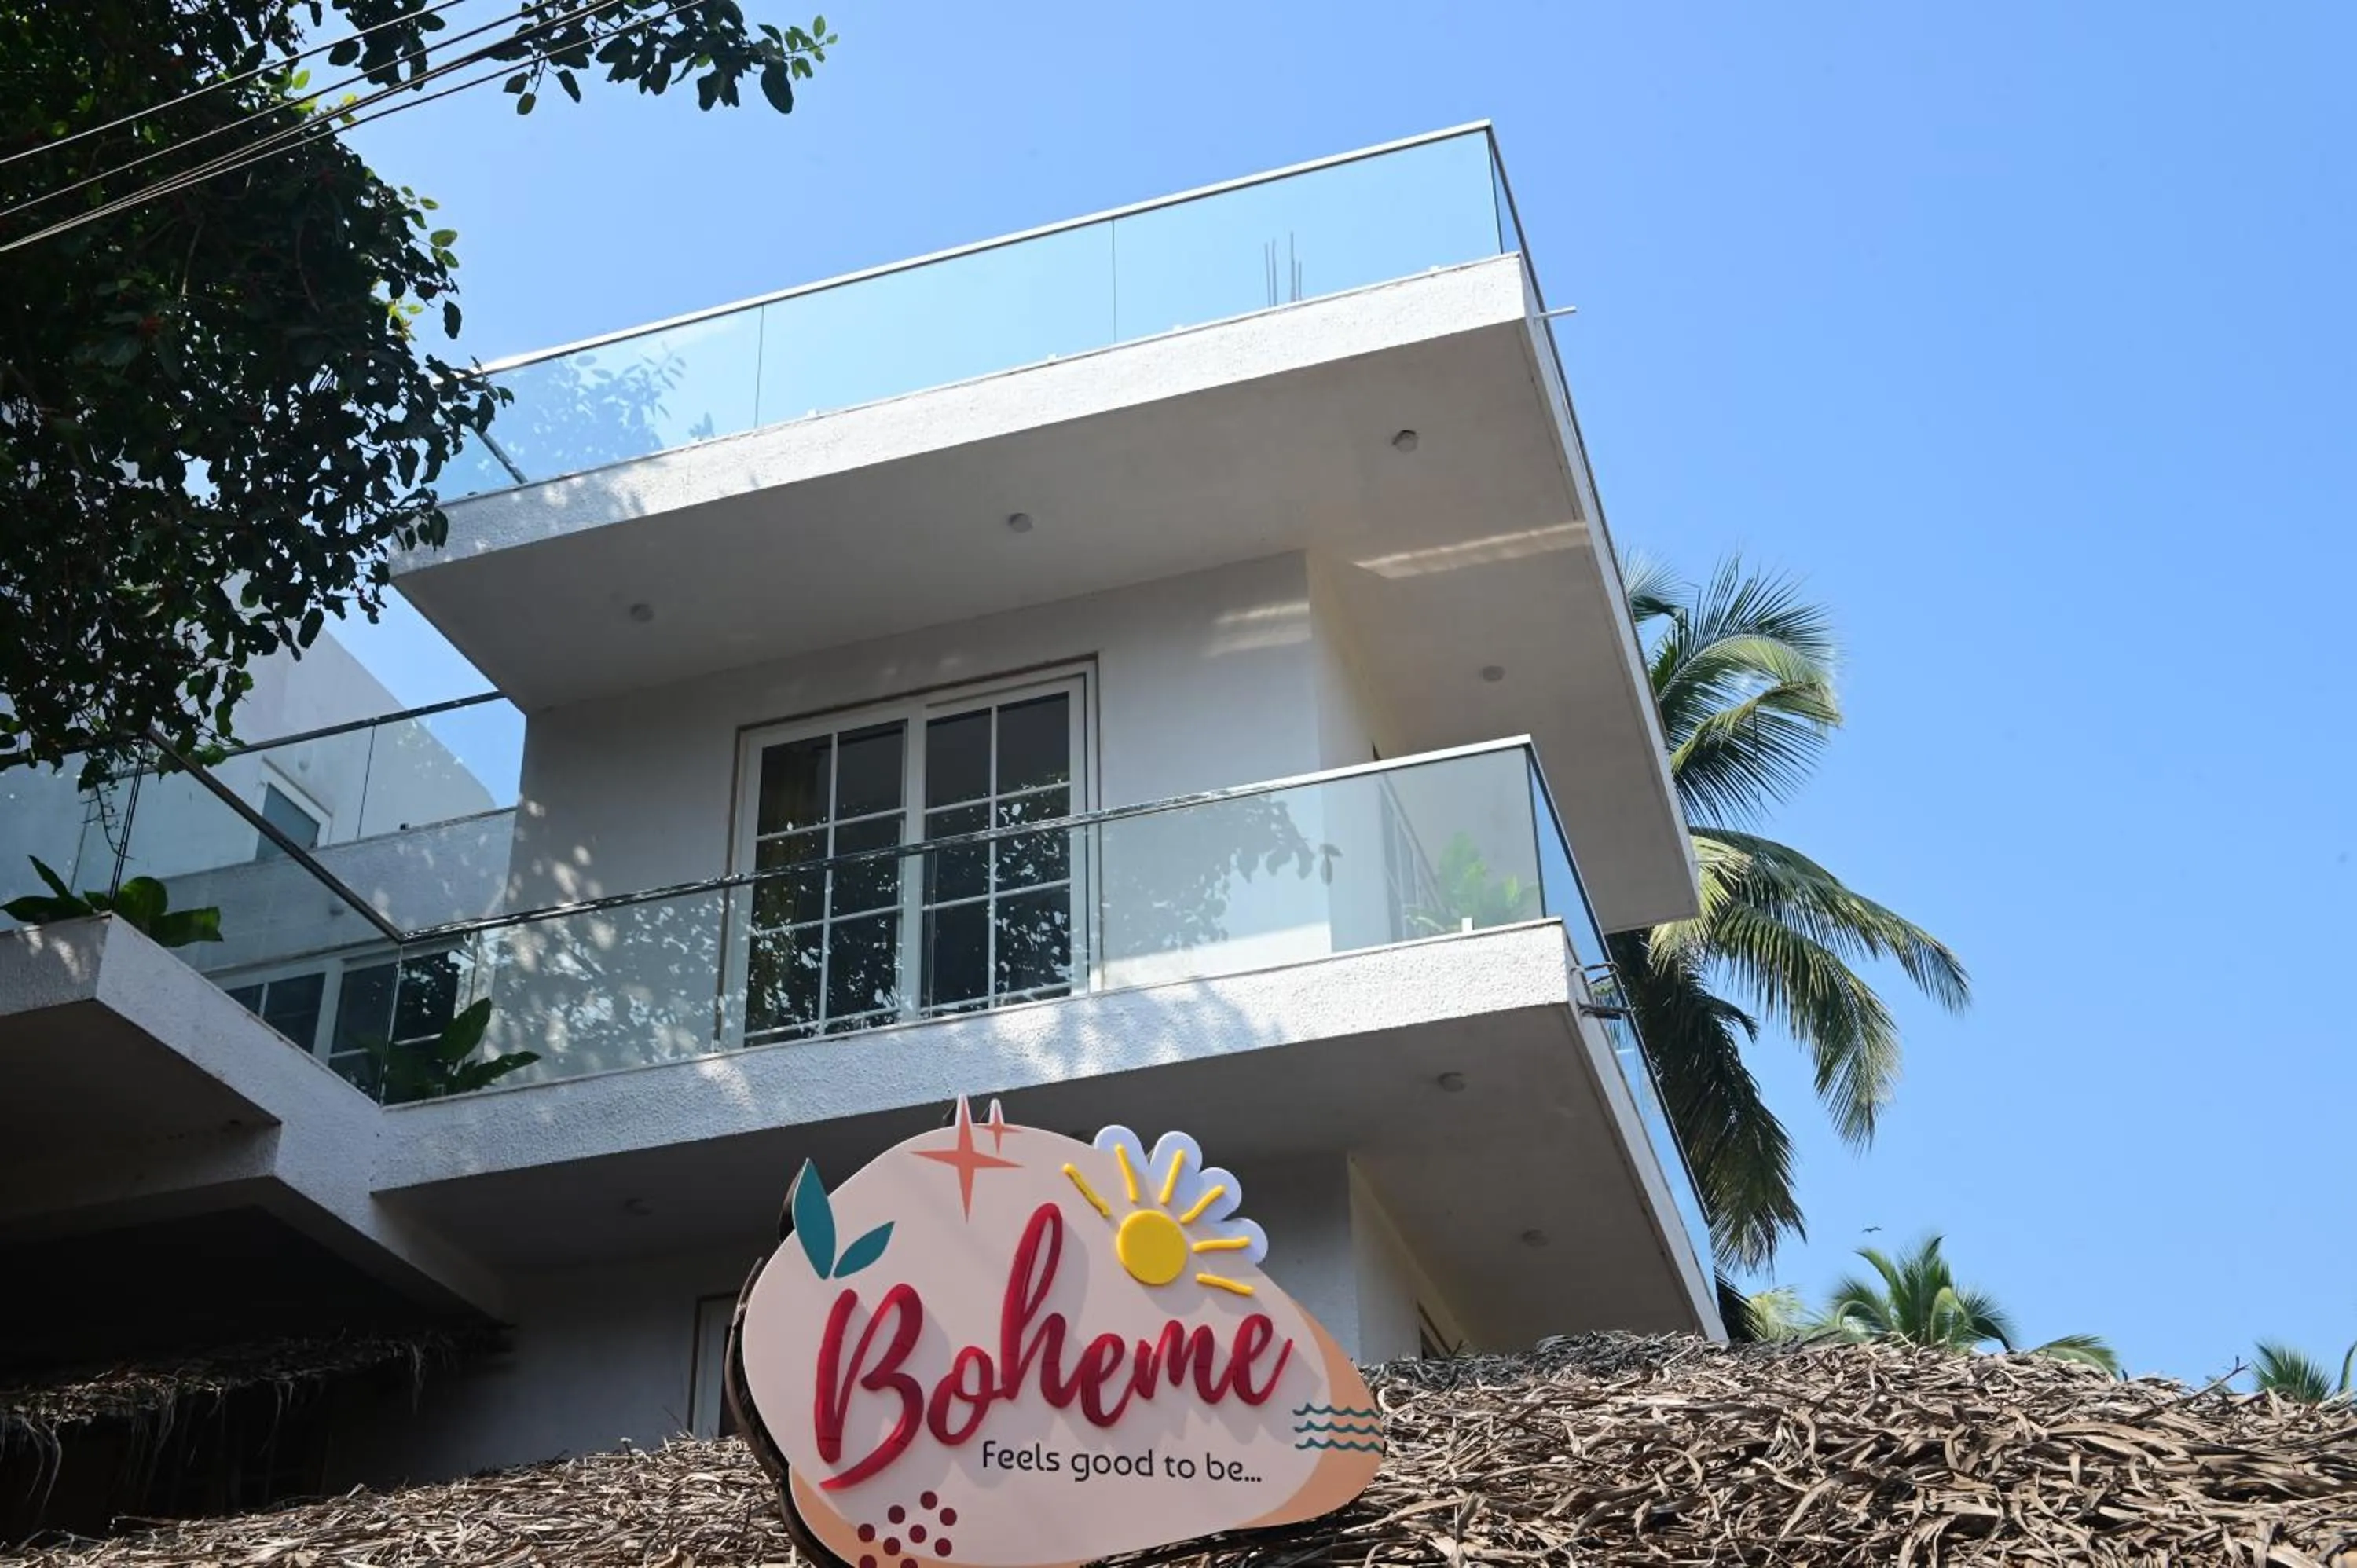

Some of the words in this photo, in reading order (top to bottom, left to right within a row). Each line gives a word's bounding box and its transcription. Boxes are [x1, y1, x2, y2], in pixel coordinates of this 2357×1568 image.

[814, 1203, 1292, 1489] Boheme
[982, 1440, 1061, 1471] Feels
[1071, 1449, 1153, 1482] good
[1164, 1456, 1196, 1478] to
[1206, 1452, 1262, 1482] be...
